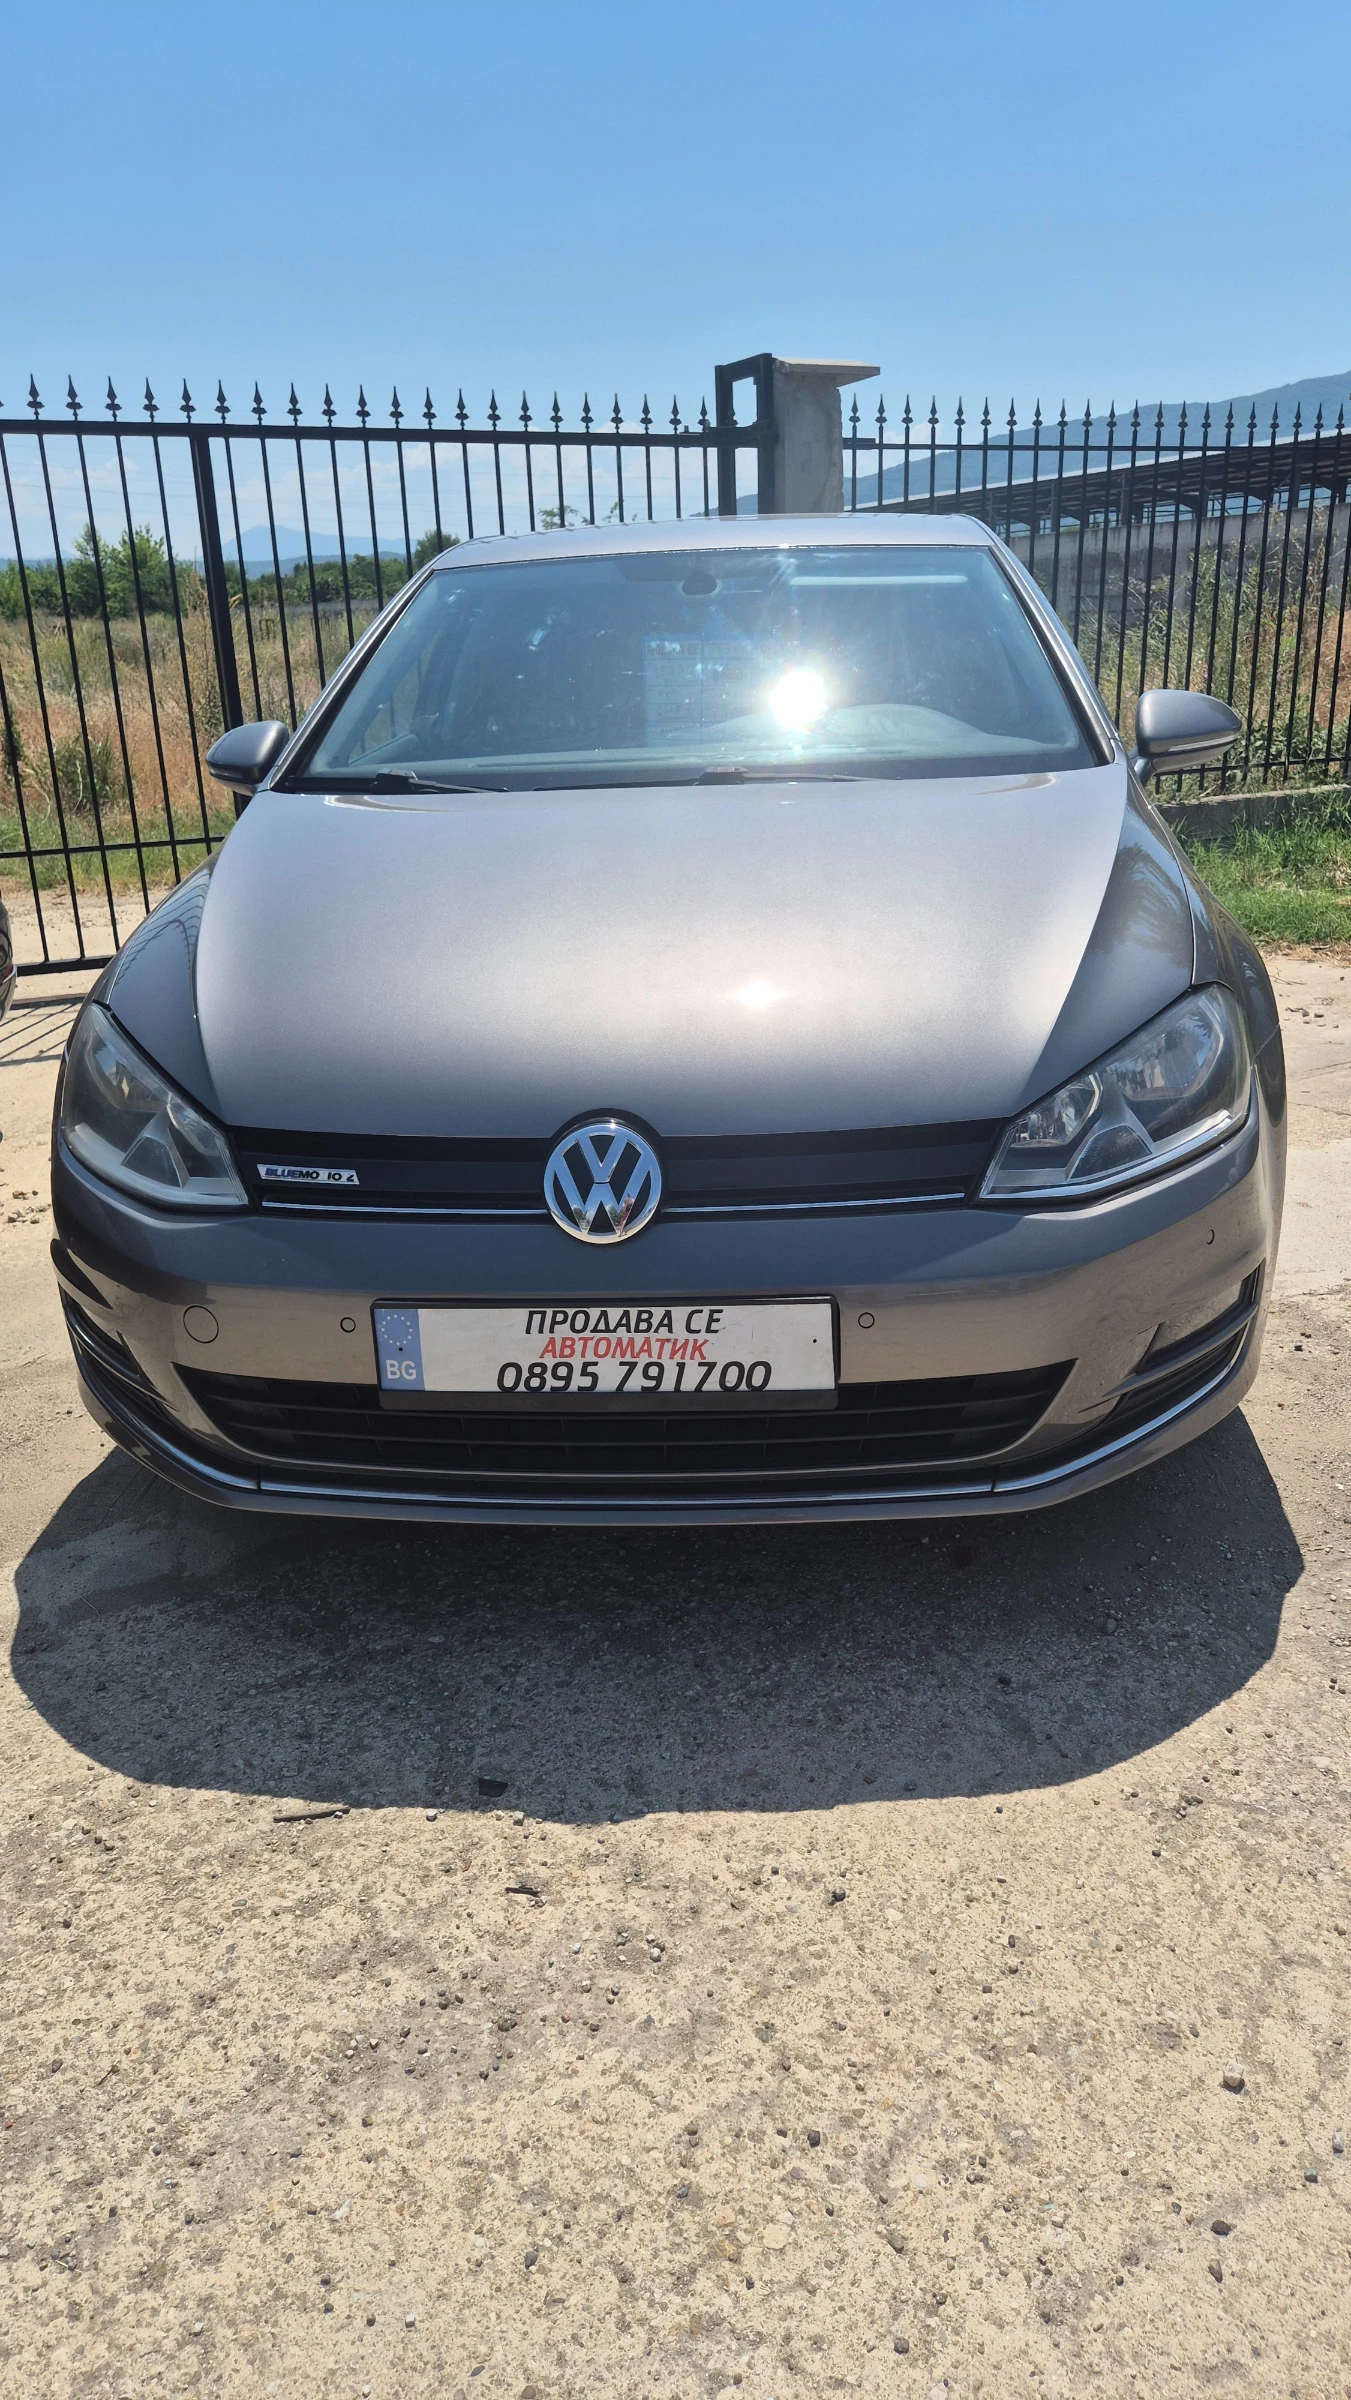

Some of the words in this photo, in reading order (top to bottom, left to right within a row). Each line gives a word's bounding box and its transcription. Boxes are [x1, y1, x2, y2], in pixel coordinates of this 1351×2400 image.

[547, 1126, 658, 1240] VW
[525, 1309, 674, 1334] ПРОДАВА
[685, 1308, 724, 1334] СЕ
[539, 1336, 709, 1361] АВТОМАТИК
[386, 1359, 418, 1380] BG
[496, 1361, 599, 1393] 0895
[615, 1360, 773, 1393] 791700
